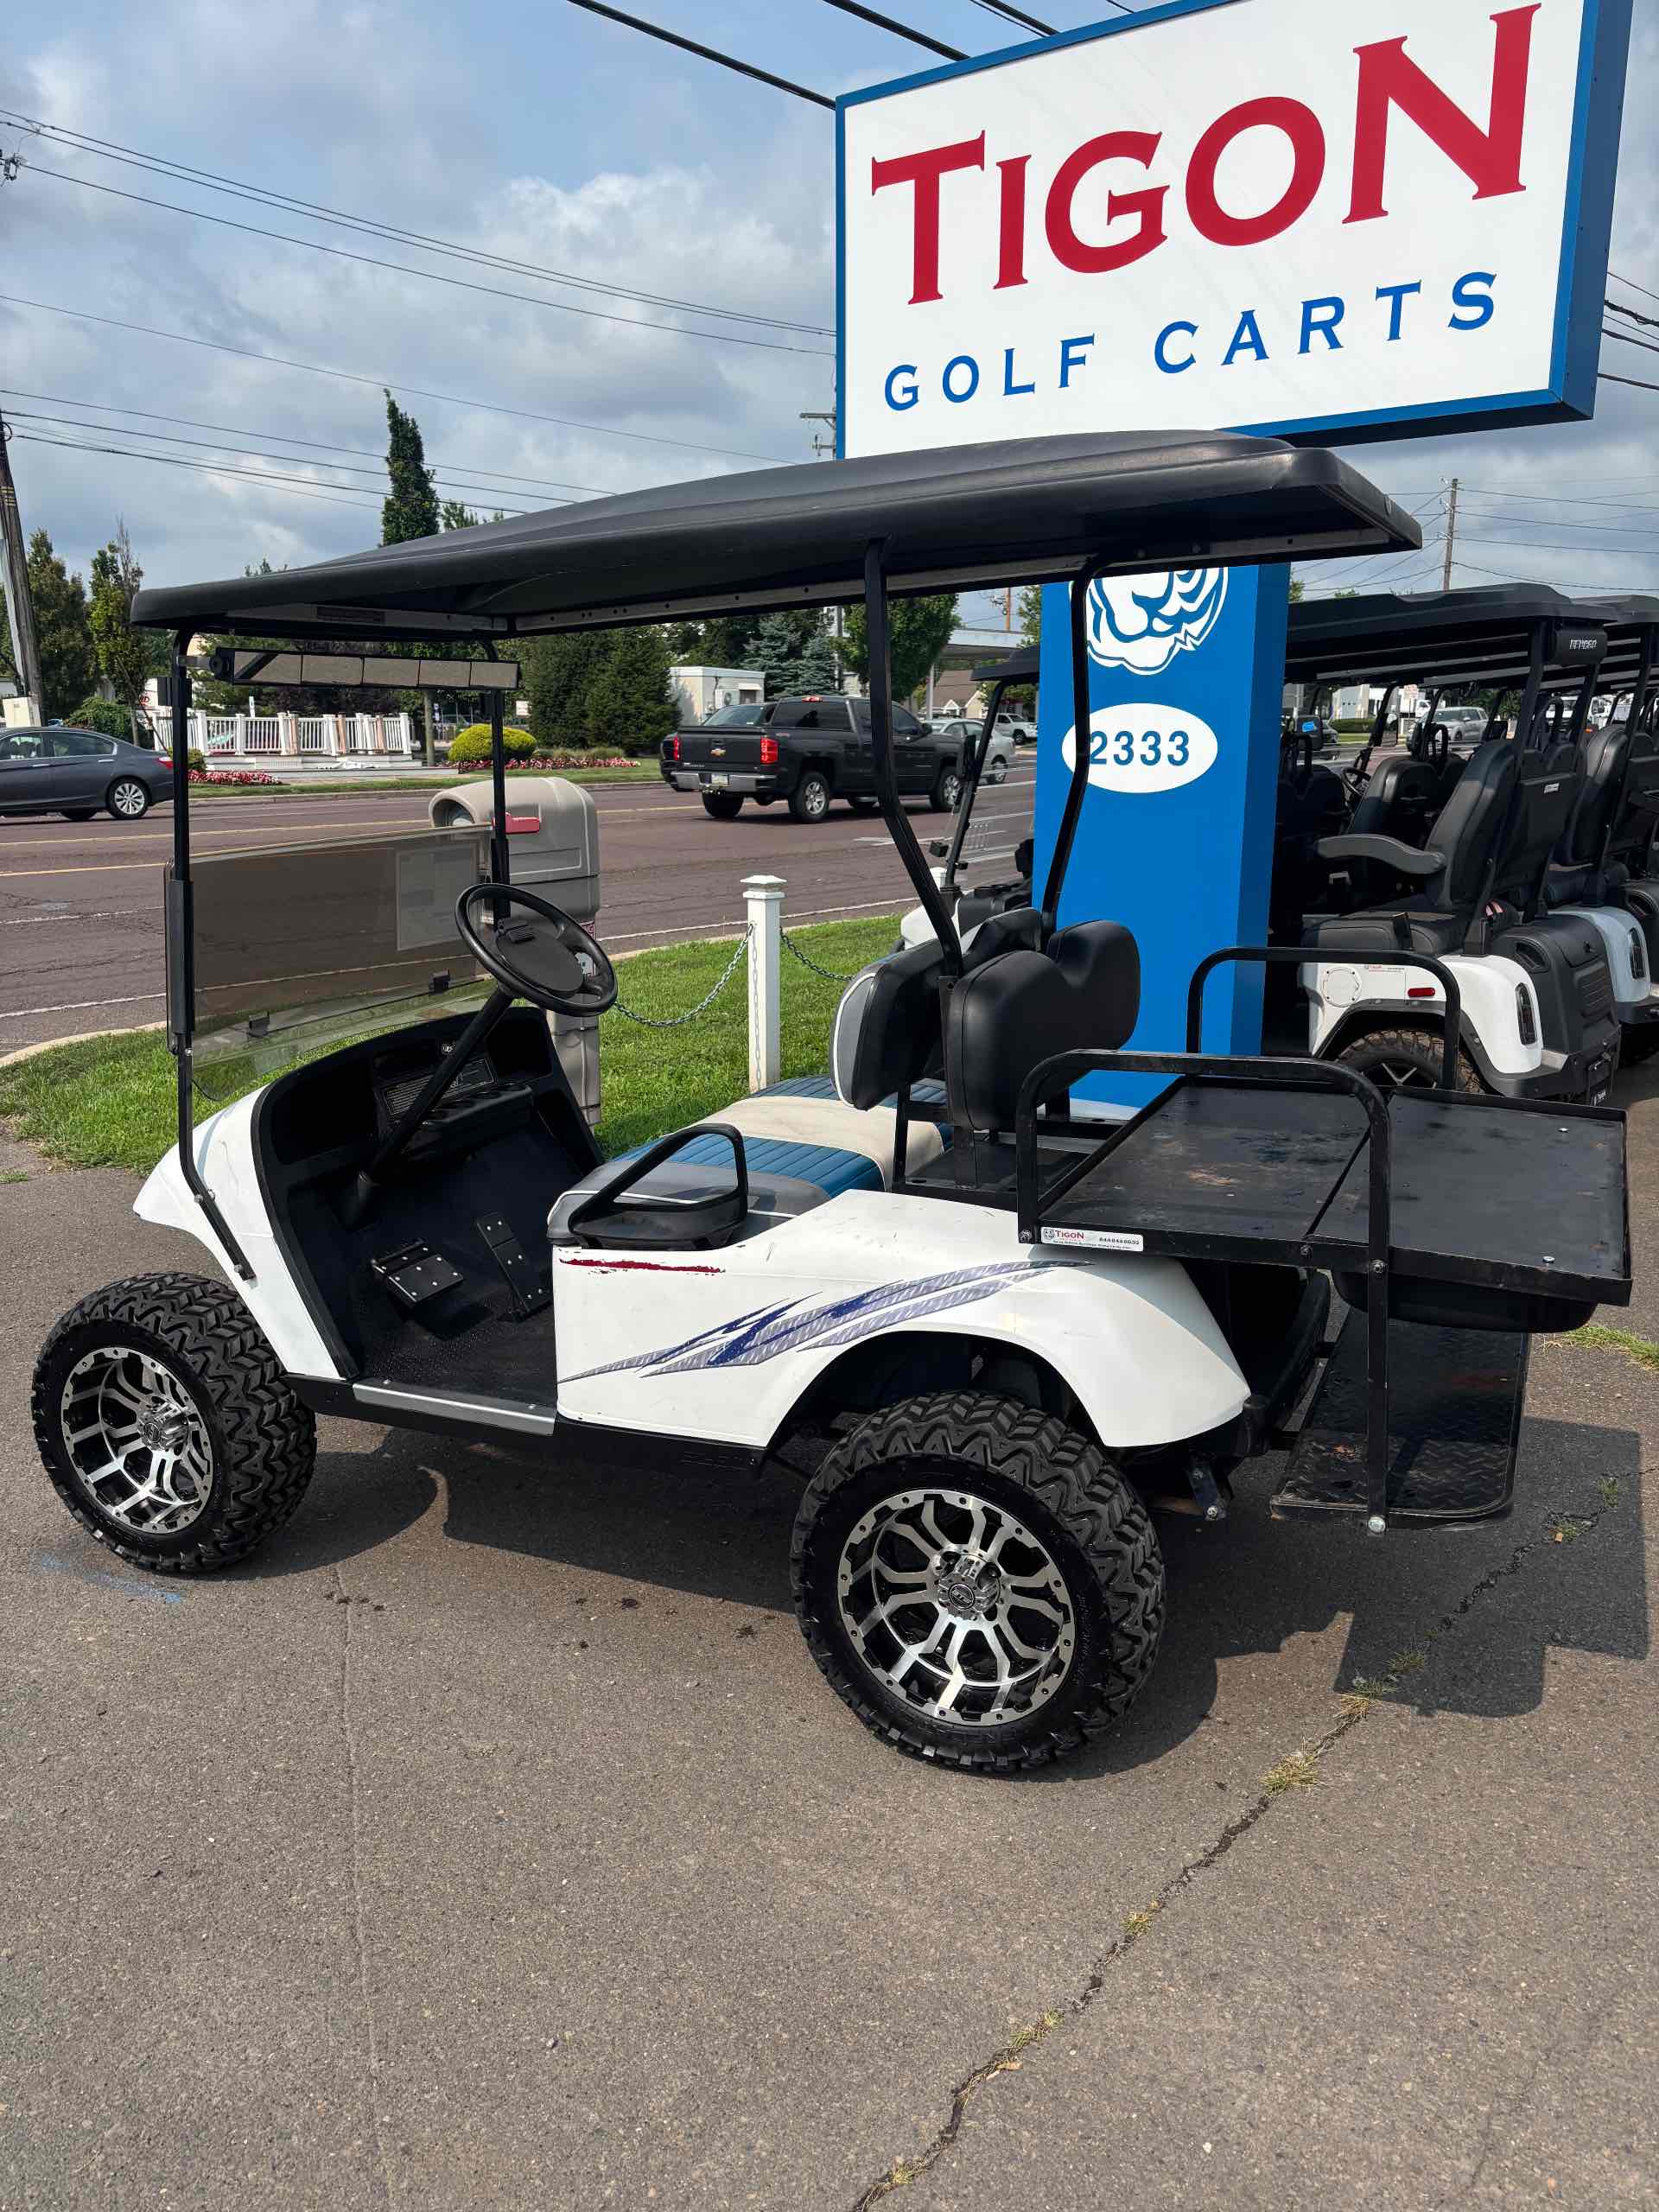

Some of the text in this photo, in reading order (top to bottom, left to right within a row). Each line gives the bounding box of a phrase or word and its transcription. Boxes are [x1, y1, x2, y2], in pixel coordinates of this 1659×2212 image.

[871, 3, 1541, 305] TIGON
[883, 270, 1497, 412] GOLF CARTS
[1088, 730, 1190, 766] 2333
[1055, 1230, 1084, 1239] TIGON
